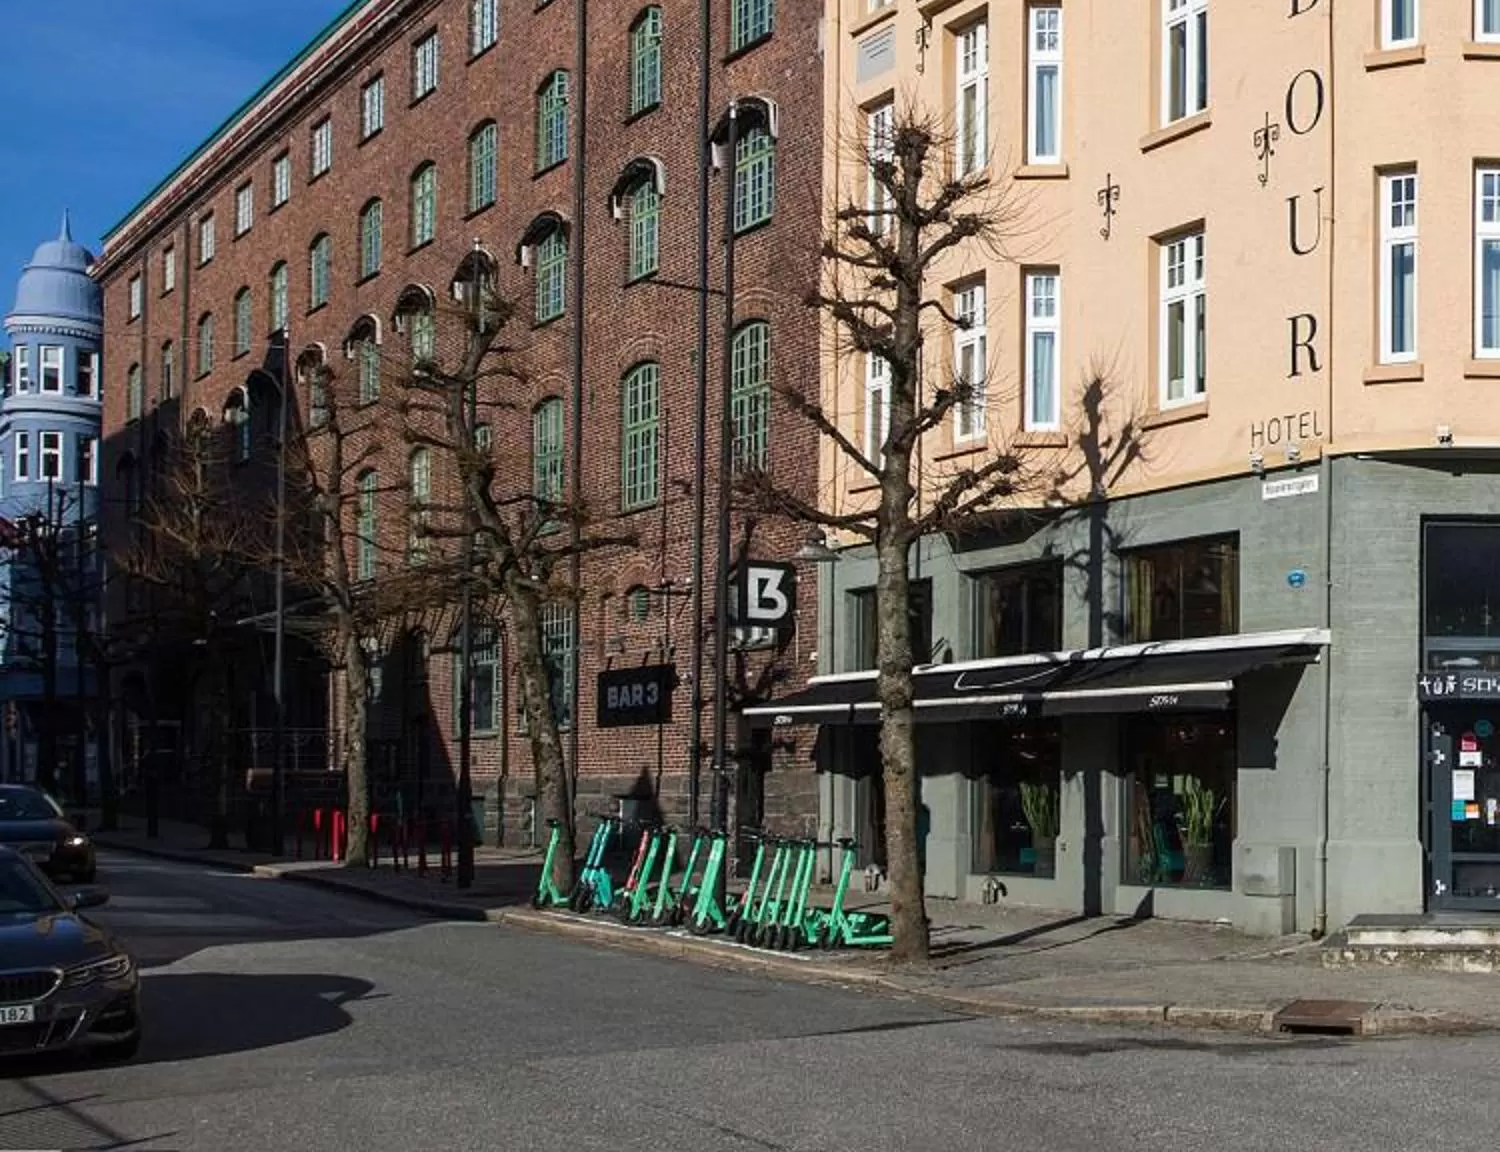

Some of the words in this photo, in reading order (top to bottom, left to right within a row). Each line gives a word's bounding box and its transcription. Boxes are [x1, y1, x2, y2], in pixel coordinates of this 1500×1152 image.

[1250, 410, 1323, 449] HOTEL
[607, 684, 644, 709] BAR
[646, 681, 660, 705] 3
